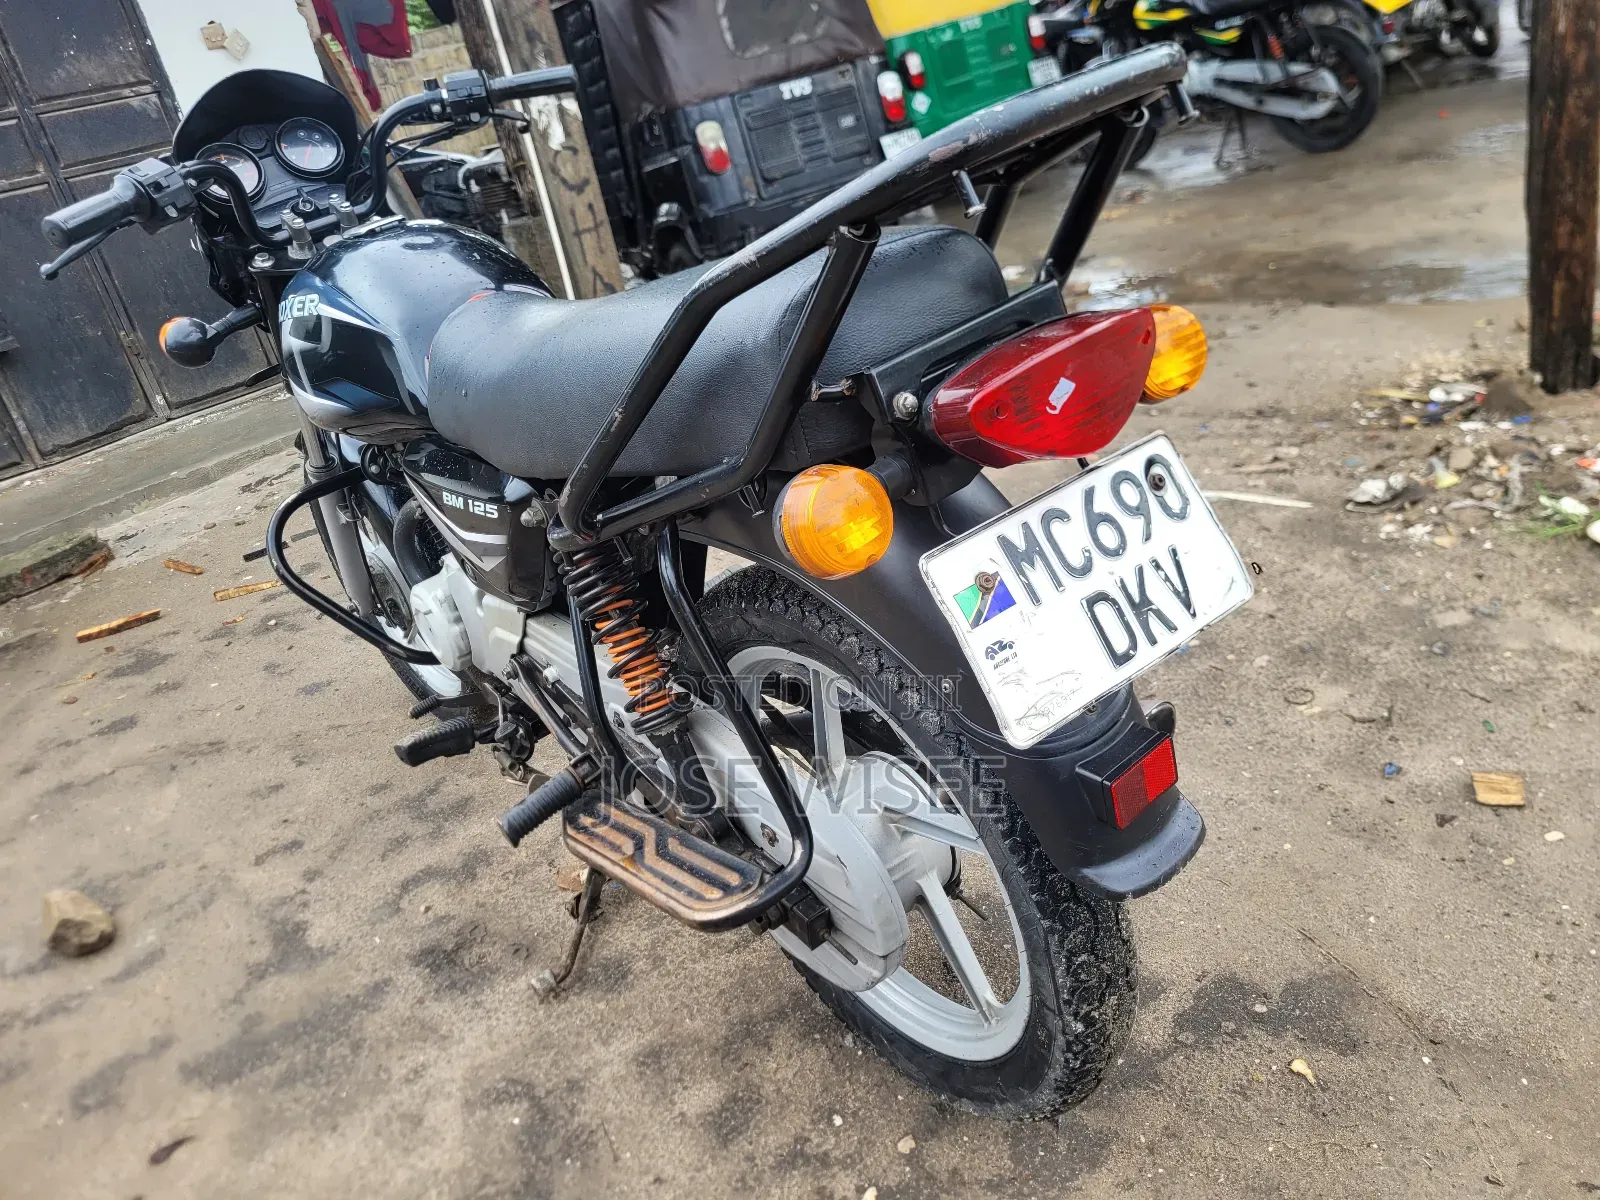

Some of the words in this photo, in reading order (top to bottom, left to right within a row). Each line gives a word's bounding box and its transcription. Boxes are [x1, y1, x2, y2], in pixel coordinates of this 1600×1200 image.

[279, 293, 320, 322] OXER
[442, 490, 464, 510] BM
[467, 499, 499, 519] 125
[996, 453, 1191, 606] MC690
[1080, 544, 1197, 669] DKV
